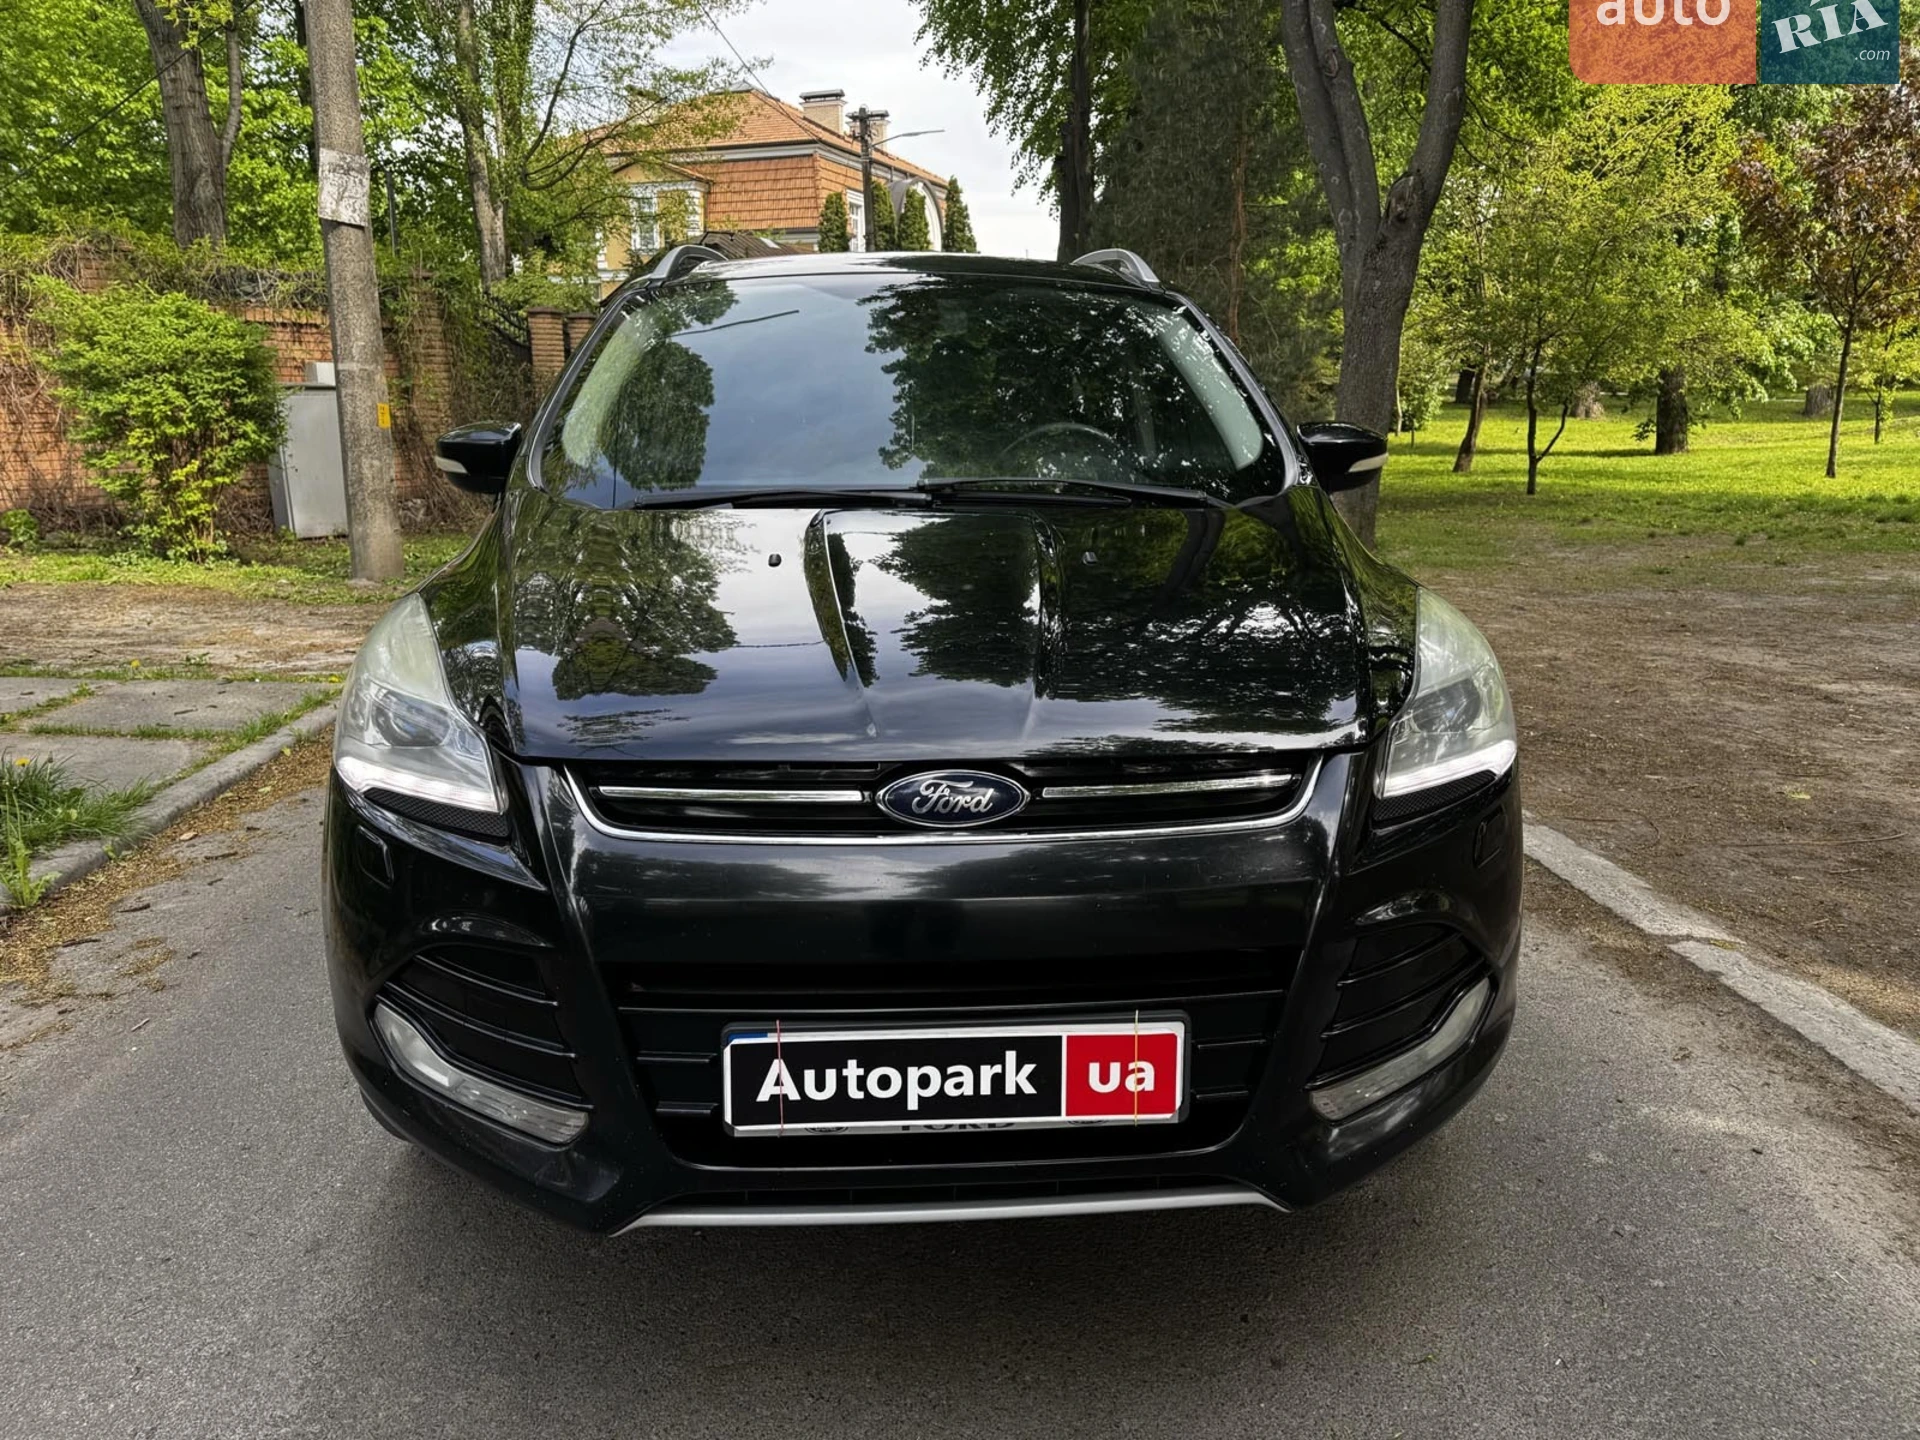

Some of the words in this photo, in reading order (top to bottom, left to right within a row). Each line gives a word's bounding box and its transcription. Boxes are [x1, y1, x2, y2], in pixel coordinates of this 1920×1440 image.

[911, 779, 995, 815] Ford
[756, 1050, 1037, 1111] Autopark
[1088, 1060, 1155, 1094] ua
